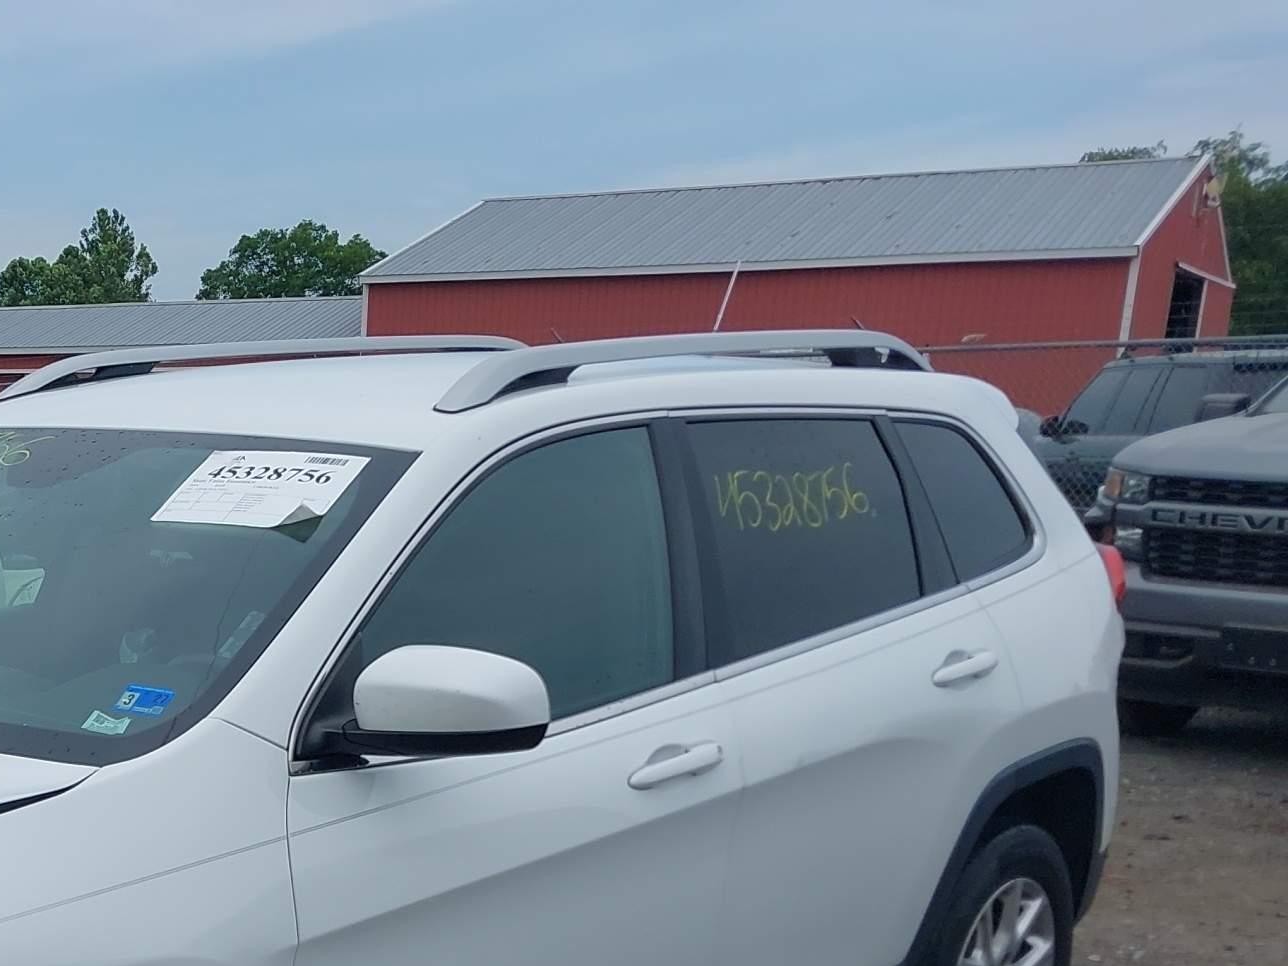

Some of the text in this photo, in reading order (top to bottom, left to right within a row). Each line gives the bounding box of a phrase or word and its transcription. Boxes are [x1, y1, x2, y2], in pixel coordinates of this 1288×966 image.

[208, 465, 336, 485] 45328756
[714, 462, 870, 532] 45328756
[123, 693, 135, 706] 3
